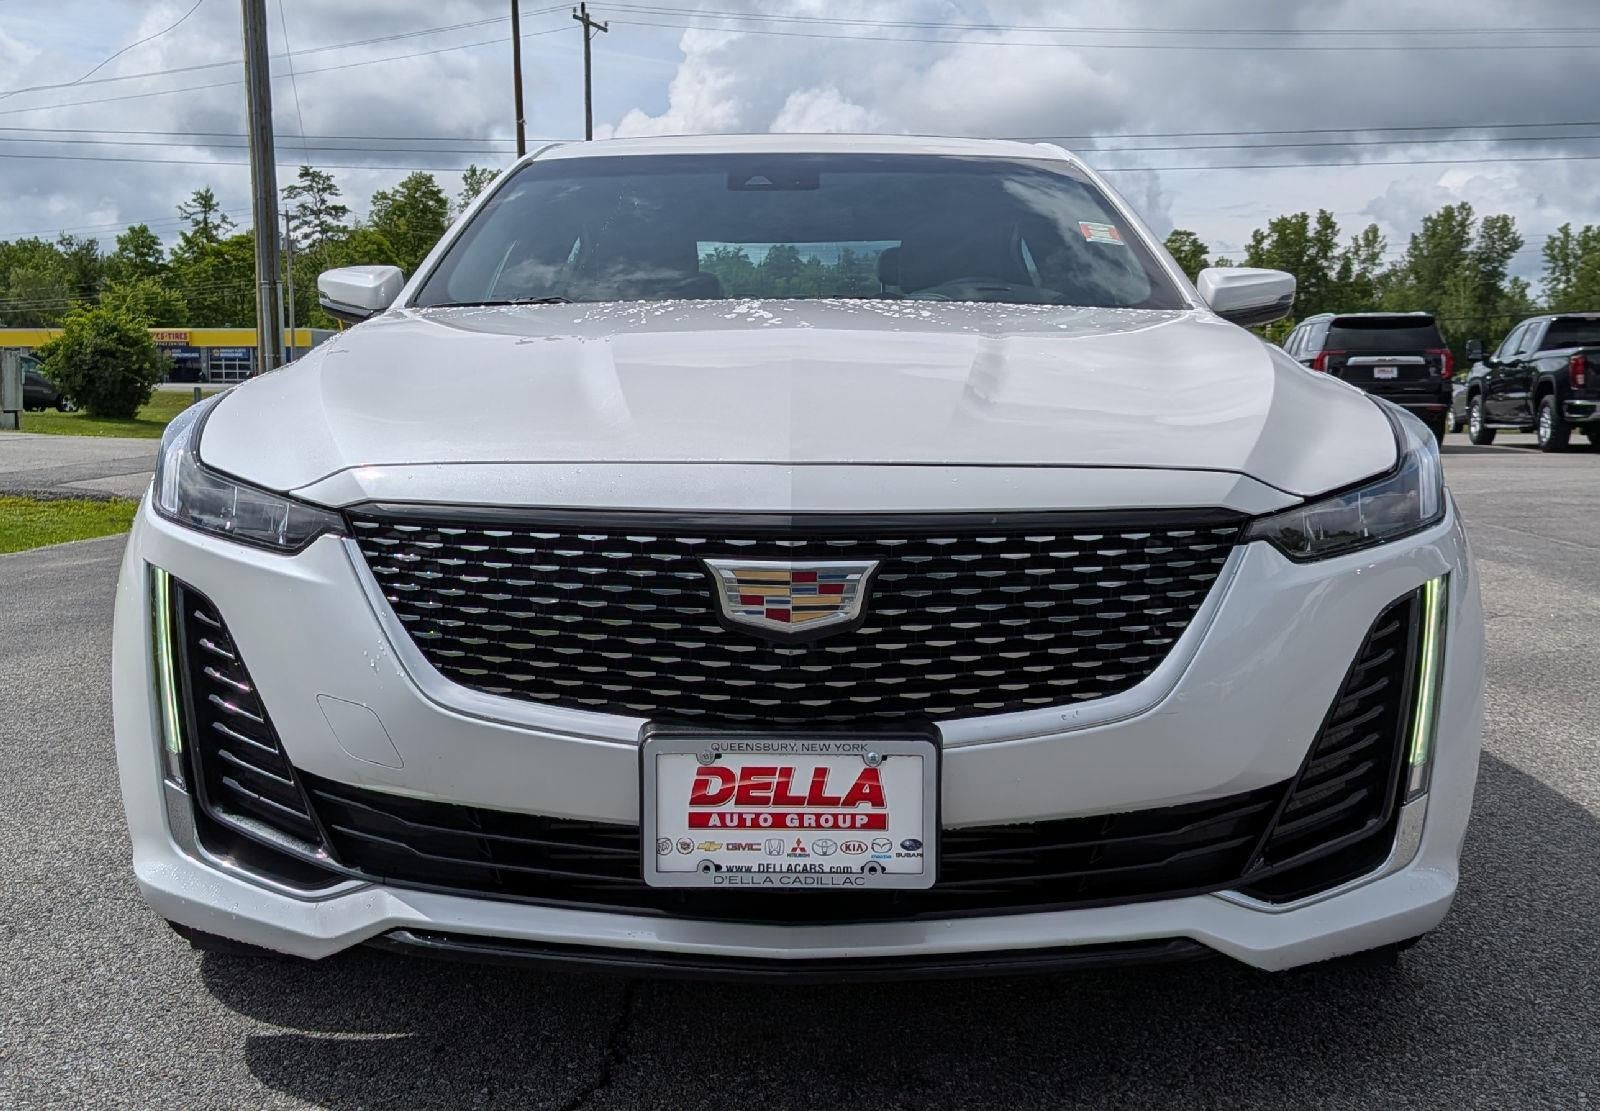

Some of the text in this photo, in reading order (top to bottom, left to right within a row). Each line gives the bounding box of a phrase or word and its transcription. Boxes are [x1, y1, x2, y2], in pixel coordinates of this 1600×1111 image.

[711, 742, 868, 752] QUEENSBURY, NEW YORK
[689, 766, 887, 808] DELLA
[708, 813, 869, 828] AUTO GROUP
[726, 843, 762, 851] GMC
[844, 844, 864, 852] KIA
[725, 863, 853, 873] www.DELLACARScom
[714, 876, 865, 885] D'ELLA CADILLAC
